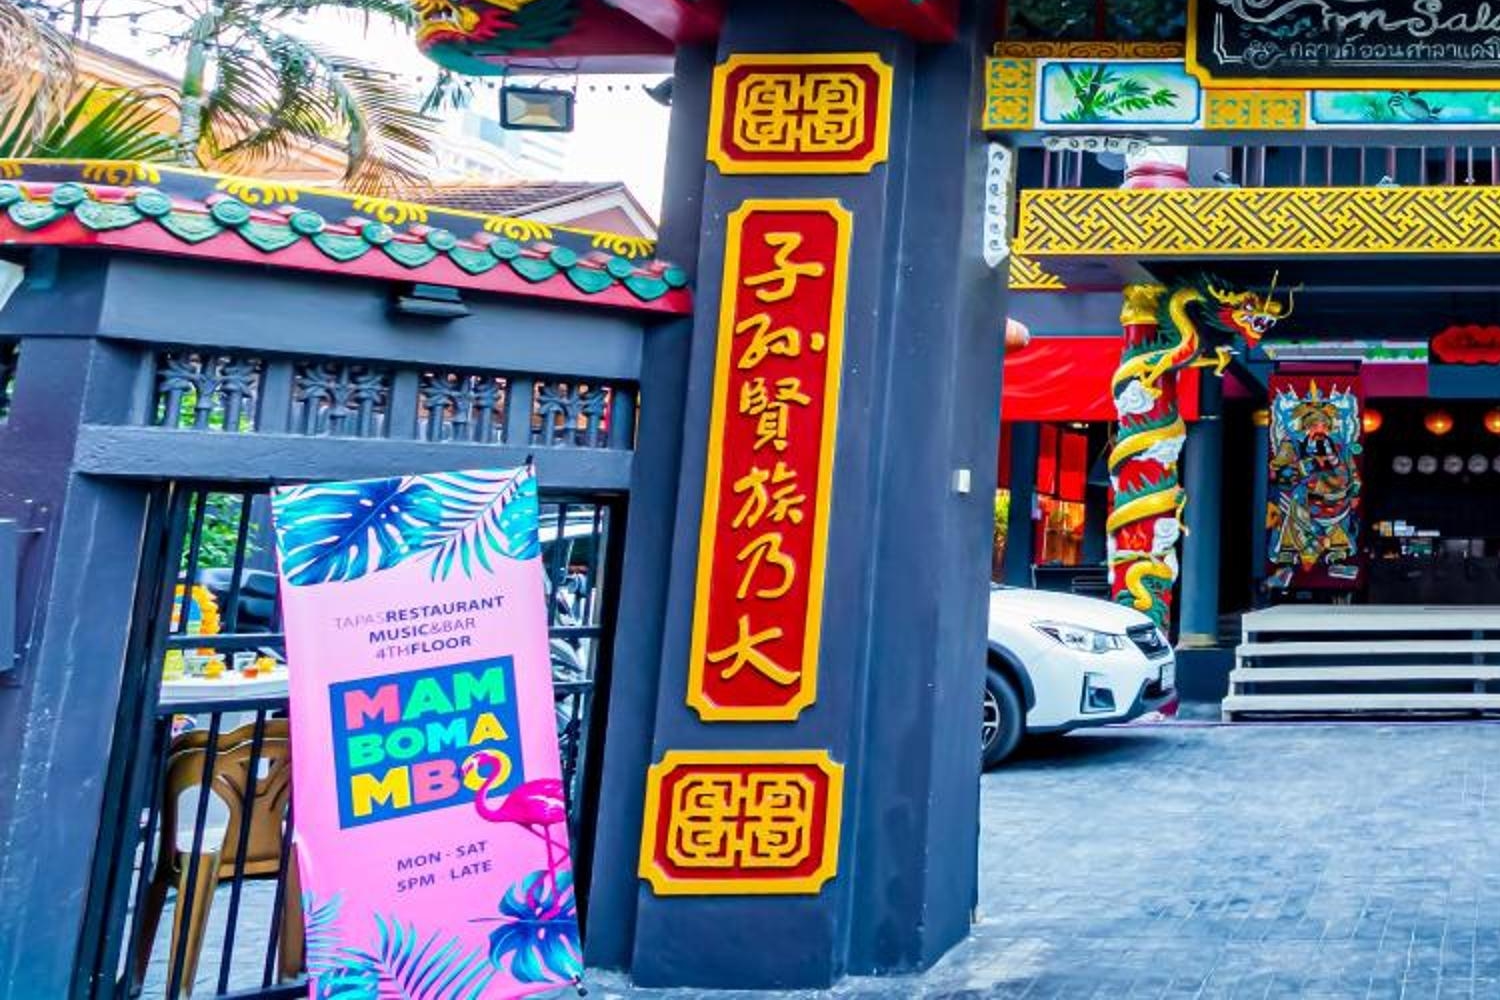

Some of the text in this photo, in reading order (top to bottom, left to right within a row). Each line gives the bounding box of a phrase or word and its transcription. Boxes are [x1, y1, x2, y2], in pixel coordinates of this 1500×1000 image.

[344, 666, 506, 730] MAM
[347, 712, 509, 768] BOMA
[351, 749, 513, 817] MBO
[397, 851, 441, 872] MON
[455, 841, 487, 857] SAT
[450, 860, 492, 879] LATE
